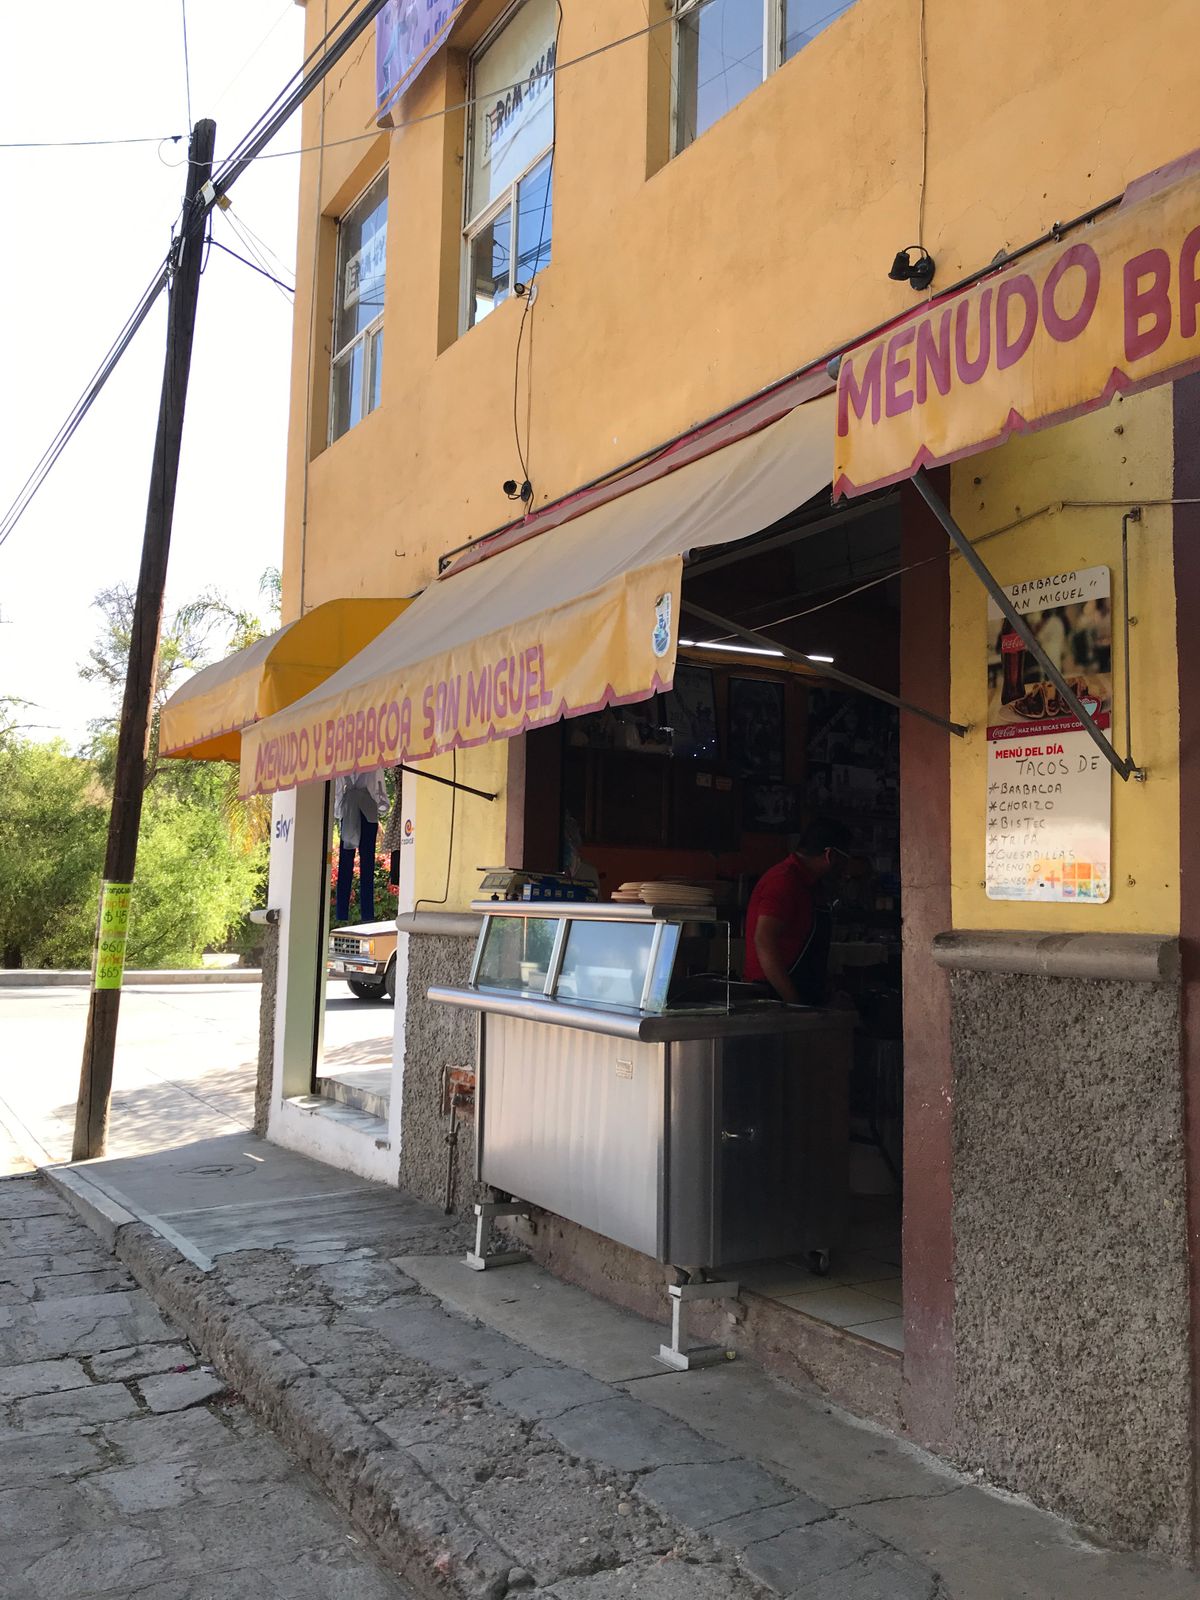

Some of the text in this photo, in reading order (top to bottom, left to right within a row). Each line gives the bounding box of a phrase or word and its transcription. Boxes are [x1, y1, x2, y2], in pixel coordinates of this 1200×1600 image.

[837, 243, 1100, 437] MENUDO
[1011, 571, 1077, 596] BARBACOA
[1011, 598, 1031, 610] AN
[255, 644, 553, 782] MENUDO Y BARBACOA SAN MIGUEL
[995, 743, 1064, 759] MENÚ DEL DÍA
[1016, 754, 1100, 776] TACOS DE
[275, 813, 291, 843] sky
